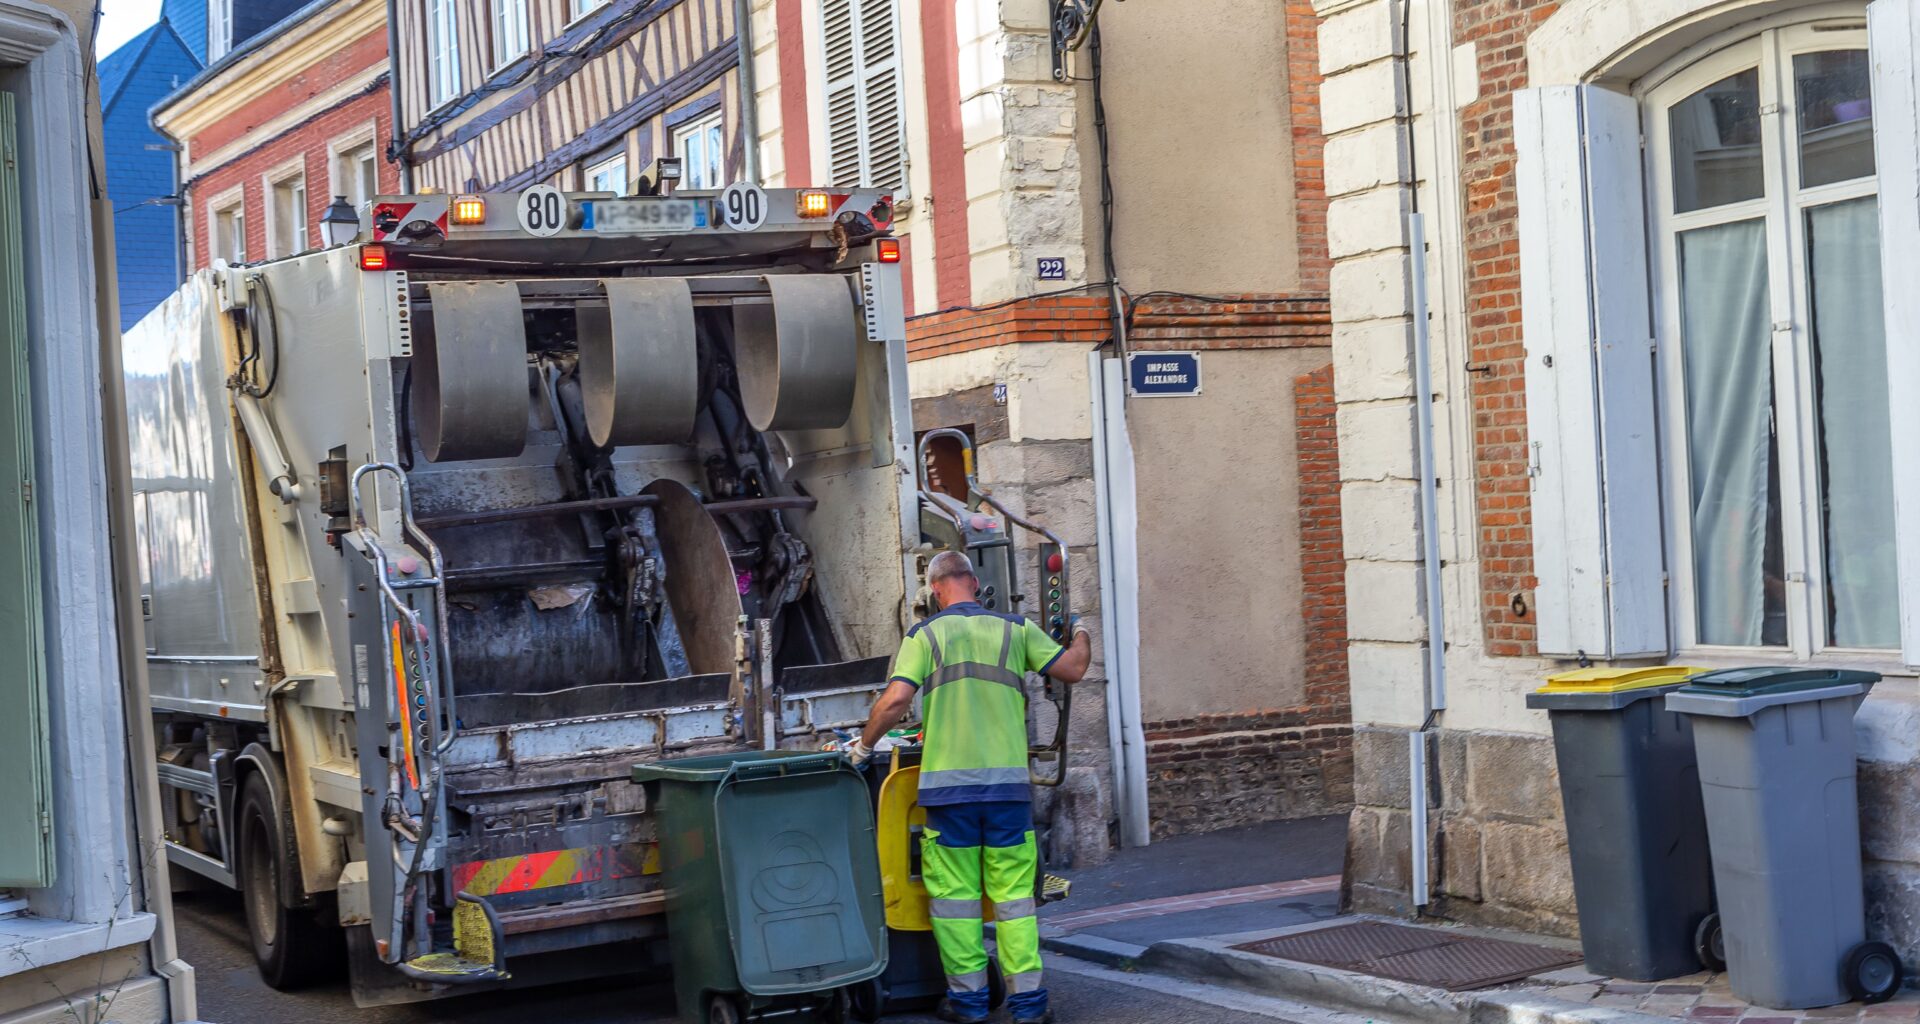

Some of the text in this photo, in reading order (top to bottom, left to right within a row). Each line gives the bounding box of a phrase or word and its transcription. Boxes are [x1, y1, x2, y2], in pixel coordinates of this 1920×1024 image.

[527, 192, 560, 230] 80
[728, 188, 760, 225] 90
[1040, 260, 1063, 277] 22
[1147, 362, 1179, 373] IMPASSE
[1144, 374, 1188, 385] ALEXANDRE
